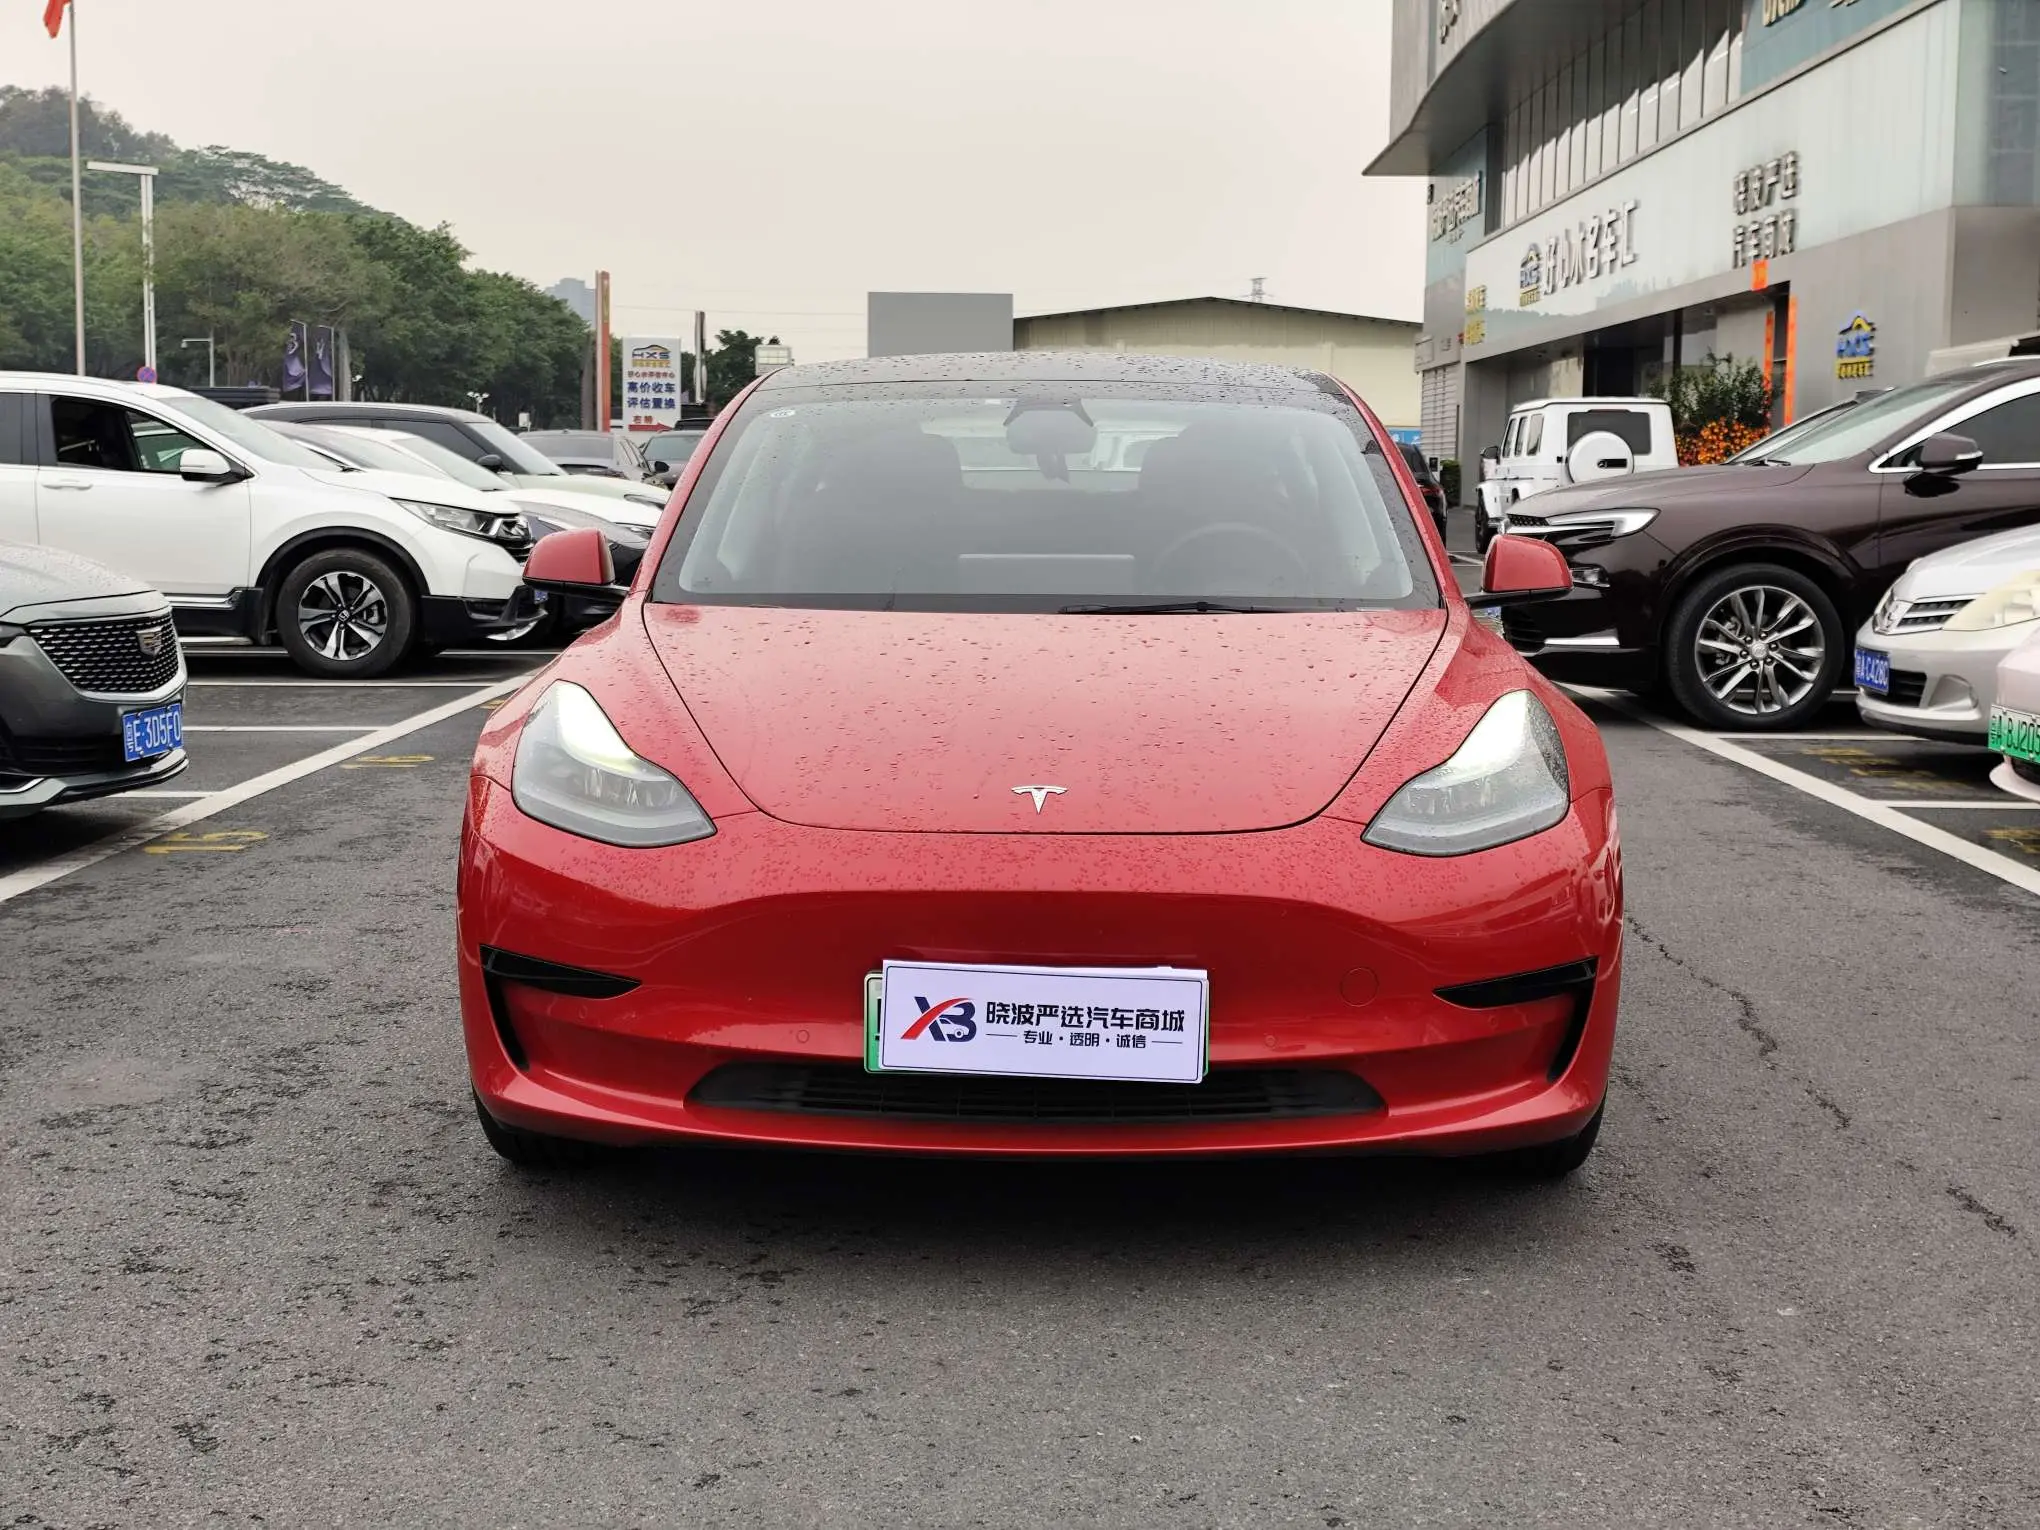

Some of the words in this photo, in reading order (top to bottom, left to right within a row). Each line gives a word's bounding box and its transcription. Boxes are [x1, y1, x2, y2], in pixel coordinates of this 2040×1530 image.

[627, 381, 676, 394] 高价收车
[627, 397, 676, 410] 评估置换
[987, 1001, 1185, 1032] 晓波严选汽车商城
